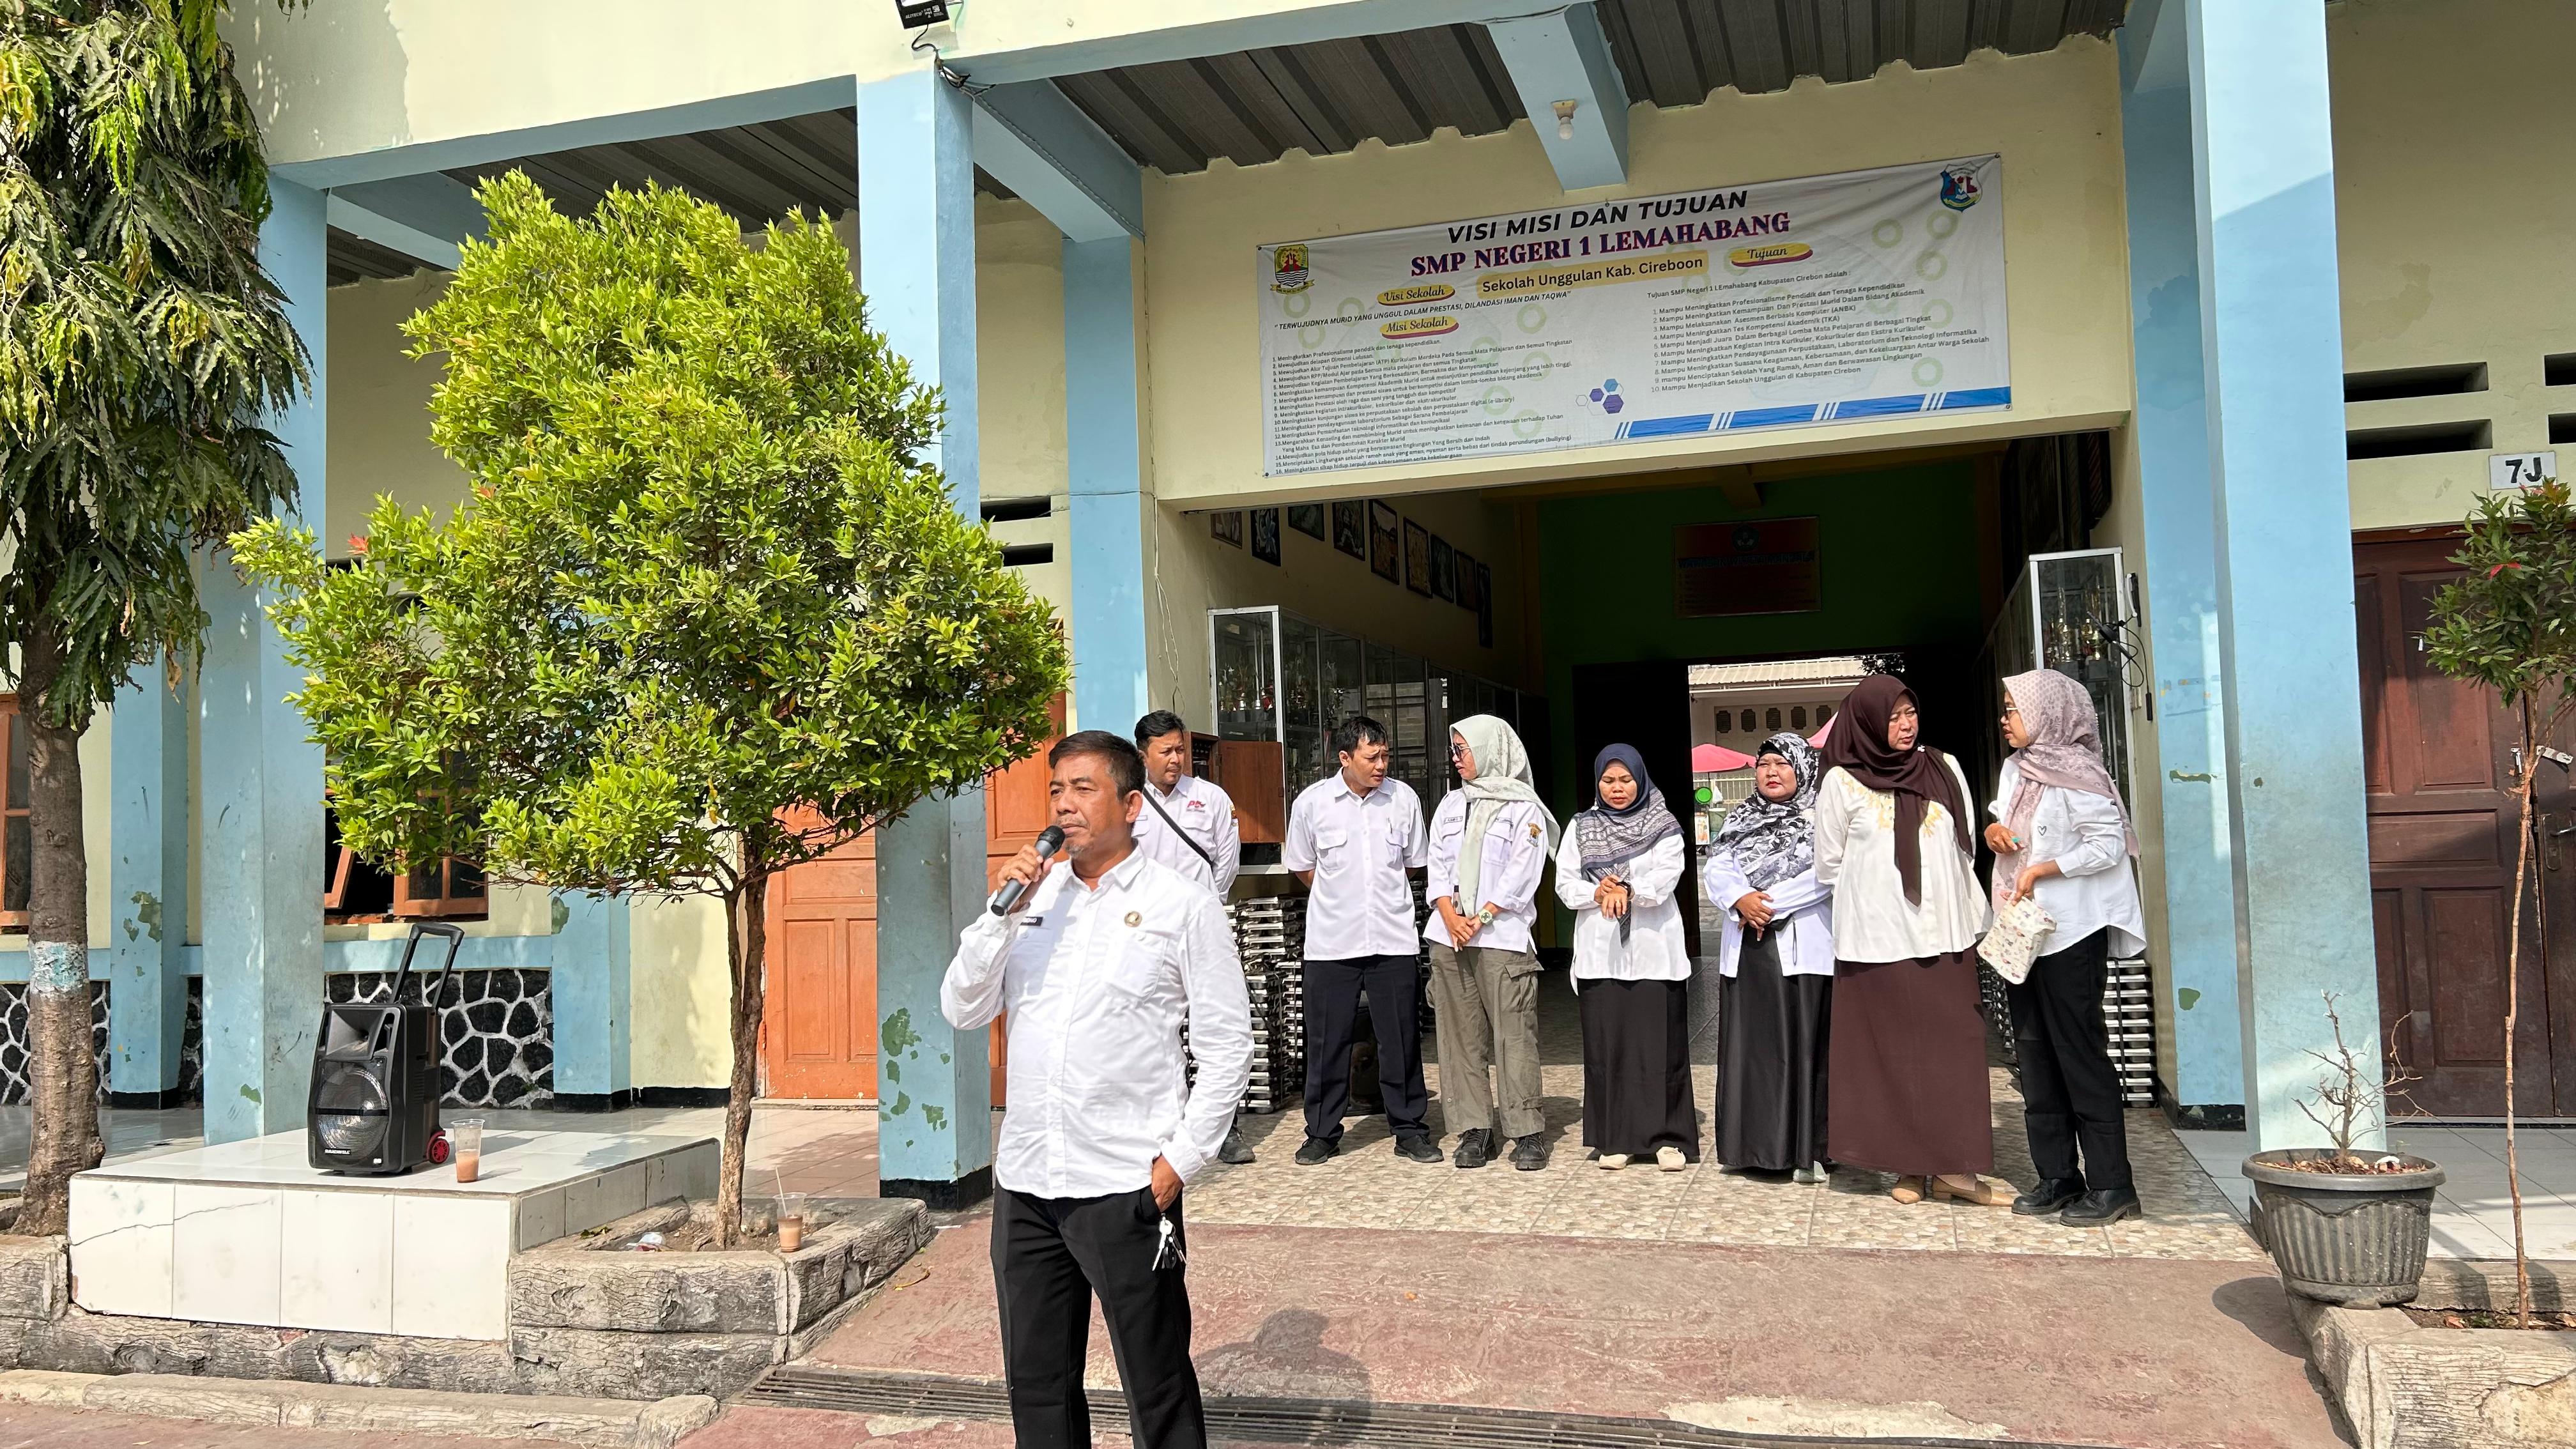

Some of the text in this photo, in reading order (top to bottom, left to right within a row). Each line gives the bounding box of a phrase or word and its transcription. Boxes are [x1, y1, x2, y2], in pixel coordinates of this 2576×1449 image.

[1448, 190, 1748, 243] VISI MISI DAN TUJUAN
[1411, 211, 1789, 277] SMP NEGERI 1 LEMAHABANG
[1747, 247, 1788, 261] Tujuan
[1483, 258, 1703, 292] Sekolah Unggulan Kab. Cireboon
[1648, 291, 1669, 299] Tujuan
[1687, 286, 1708, 294] Negeri
[1758, 277, 1795, 286] Kabupaten
[1796, 273, 1823, 282] Cirebon
[1825, 270, 1847, 279] adalah
[1384, 285, 1445, 302] Visi Sekolah
[1685, 302, 1731, 311] Meningkatkan
[1732, 295, 1785, 306] Profesionalisme
[1787, 291, 1816, 300] Pendidik
[1858, 282, 1905, 293] Kependidikan
[1685, 310, 1731, 320] Meningkatkan
[1733, 305, 1774, 314] Kemampuan
[1890, 288, 1924, 298] Akademik
[1279, 318, 1328, 330] TERWUJUDNYA
[1330, 316, 1352, 324] MURID
[1354, 313, 1372, 321] YANG
[1374, 310, 1400, 319] UNGGUL
[1403, 307, 1428, 316] DALAM
[1429, 303, 1462, 312] PRESTASI,
[1464, 298, 1503, 309] DILANDASI
[1503, 296, 1522, 304] IMAN
[1386, 316, 1448, 333] Misi Sekolah
[1685, 319, 1731, 328] Melaksanakan
[1766, 311, 1794, 320] Berbasis
[1796, 308, 1828, 316] Komputer
[1832, 304, 1856, 313] (ANBK)
[1686, 328, 1731, 337] Meningkatkan
[1746, 321, 1786, 331] Kompetensi
[1788, 317, 1820, 326] Akademik
[1821, 315, 1840, 323] (TKA)
[1686, 337, 1712, 346] Menjadi
[1758, 329, 1787, 338] Berbagai
[1832, 322, 1864, 330] Pelajaran
[1874, 318, 1904, 326] Berbagai
[1906, 315, 1931, 323] Tingkat
[1687, 345, 1732, 354] Meningkatkan
[1734, 342, 1762, 350] Kegiatan
[1816, 332, 1854, 341] Kokurikuler
[1894, 325, 1925, 333] Kurikuler
[1687, 353, 1733, 363] Meningkatkan
[1734, 348, 1787, 358] Pendayagunaan
[1838, 338, 1885, 348] Laboratorium
[1936, 328, 1977, 337] Informatika
[1687, 362, 1733, 371] Meningkatkan
[1869, 344, 1915, 353] Kekeluargaan
[1961, 336, 1989, 344] Sekolah
[1687, 371, 1729, 380] Menciptakan
[1731, 367, 1757, 376] Sekolah
[1839, 356, 1881, 365] Berwawasan
[1883, 352, 1922, 362] Lingkungan
[1688, 380, 1726, 389] Menjadikan
[1754, 374, 1786, 383] Unggulan
[1796, 370, 1832, 378] Kabupaten
[2505, 457, 2542, 483] 7J
